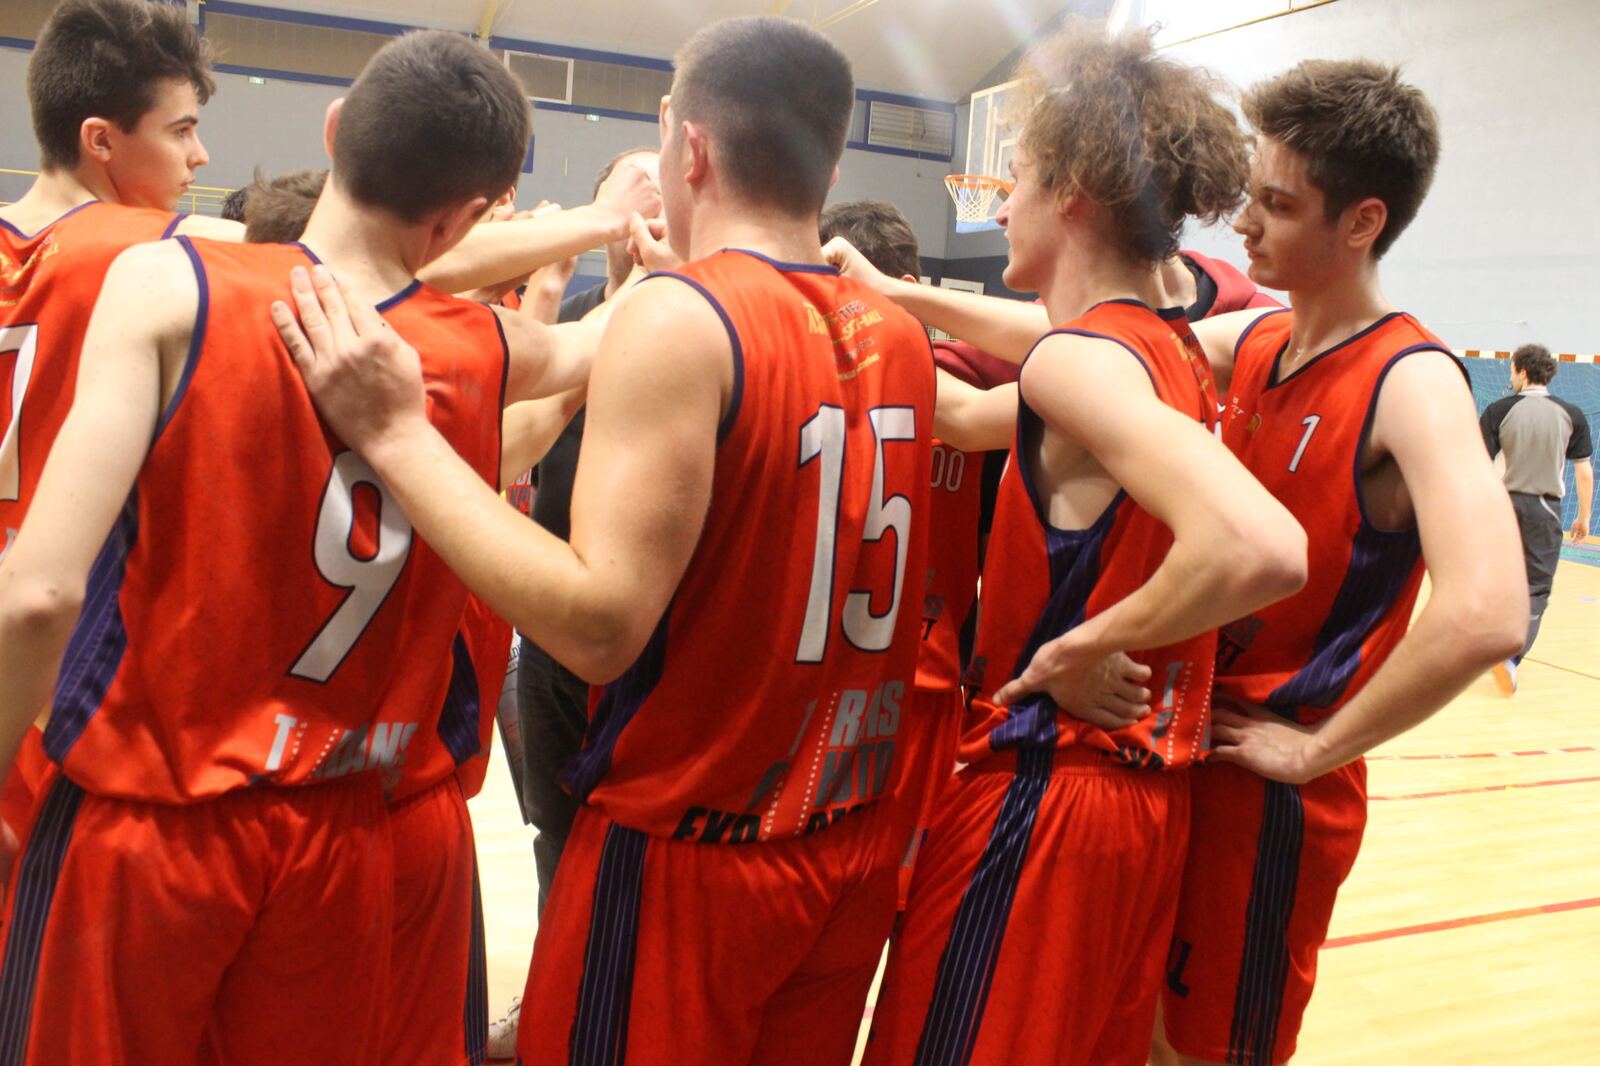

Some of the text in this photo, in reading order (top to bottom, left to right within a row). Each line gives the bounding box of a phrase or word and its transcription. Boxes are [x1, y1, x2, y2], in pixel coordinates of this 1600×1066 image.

[795, 403, 916, 665] 15
[1286, 412, 1322, 474] 1
[285, 449, 416, 686] 9
